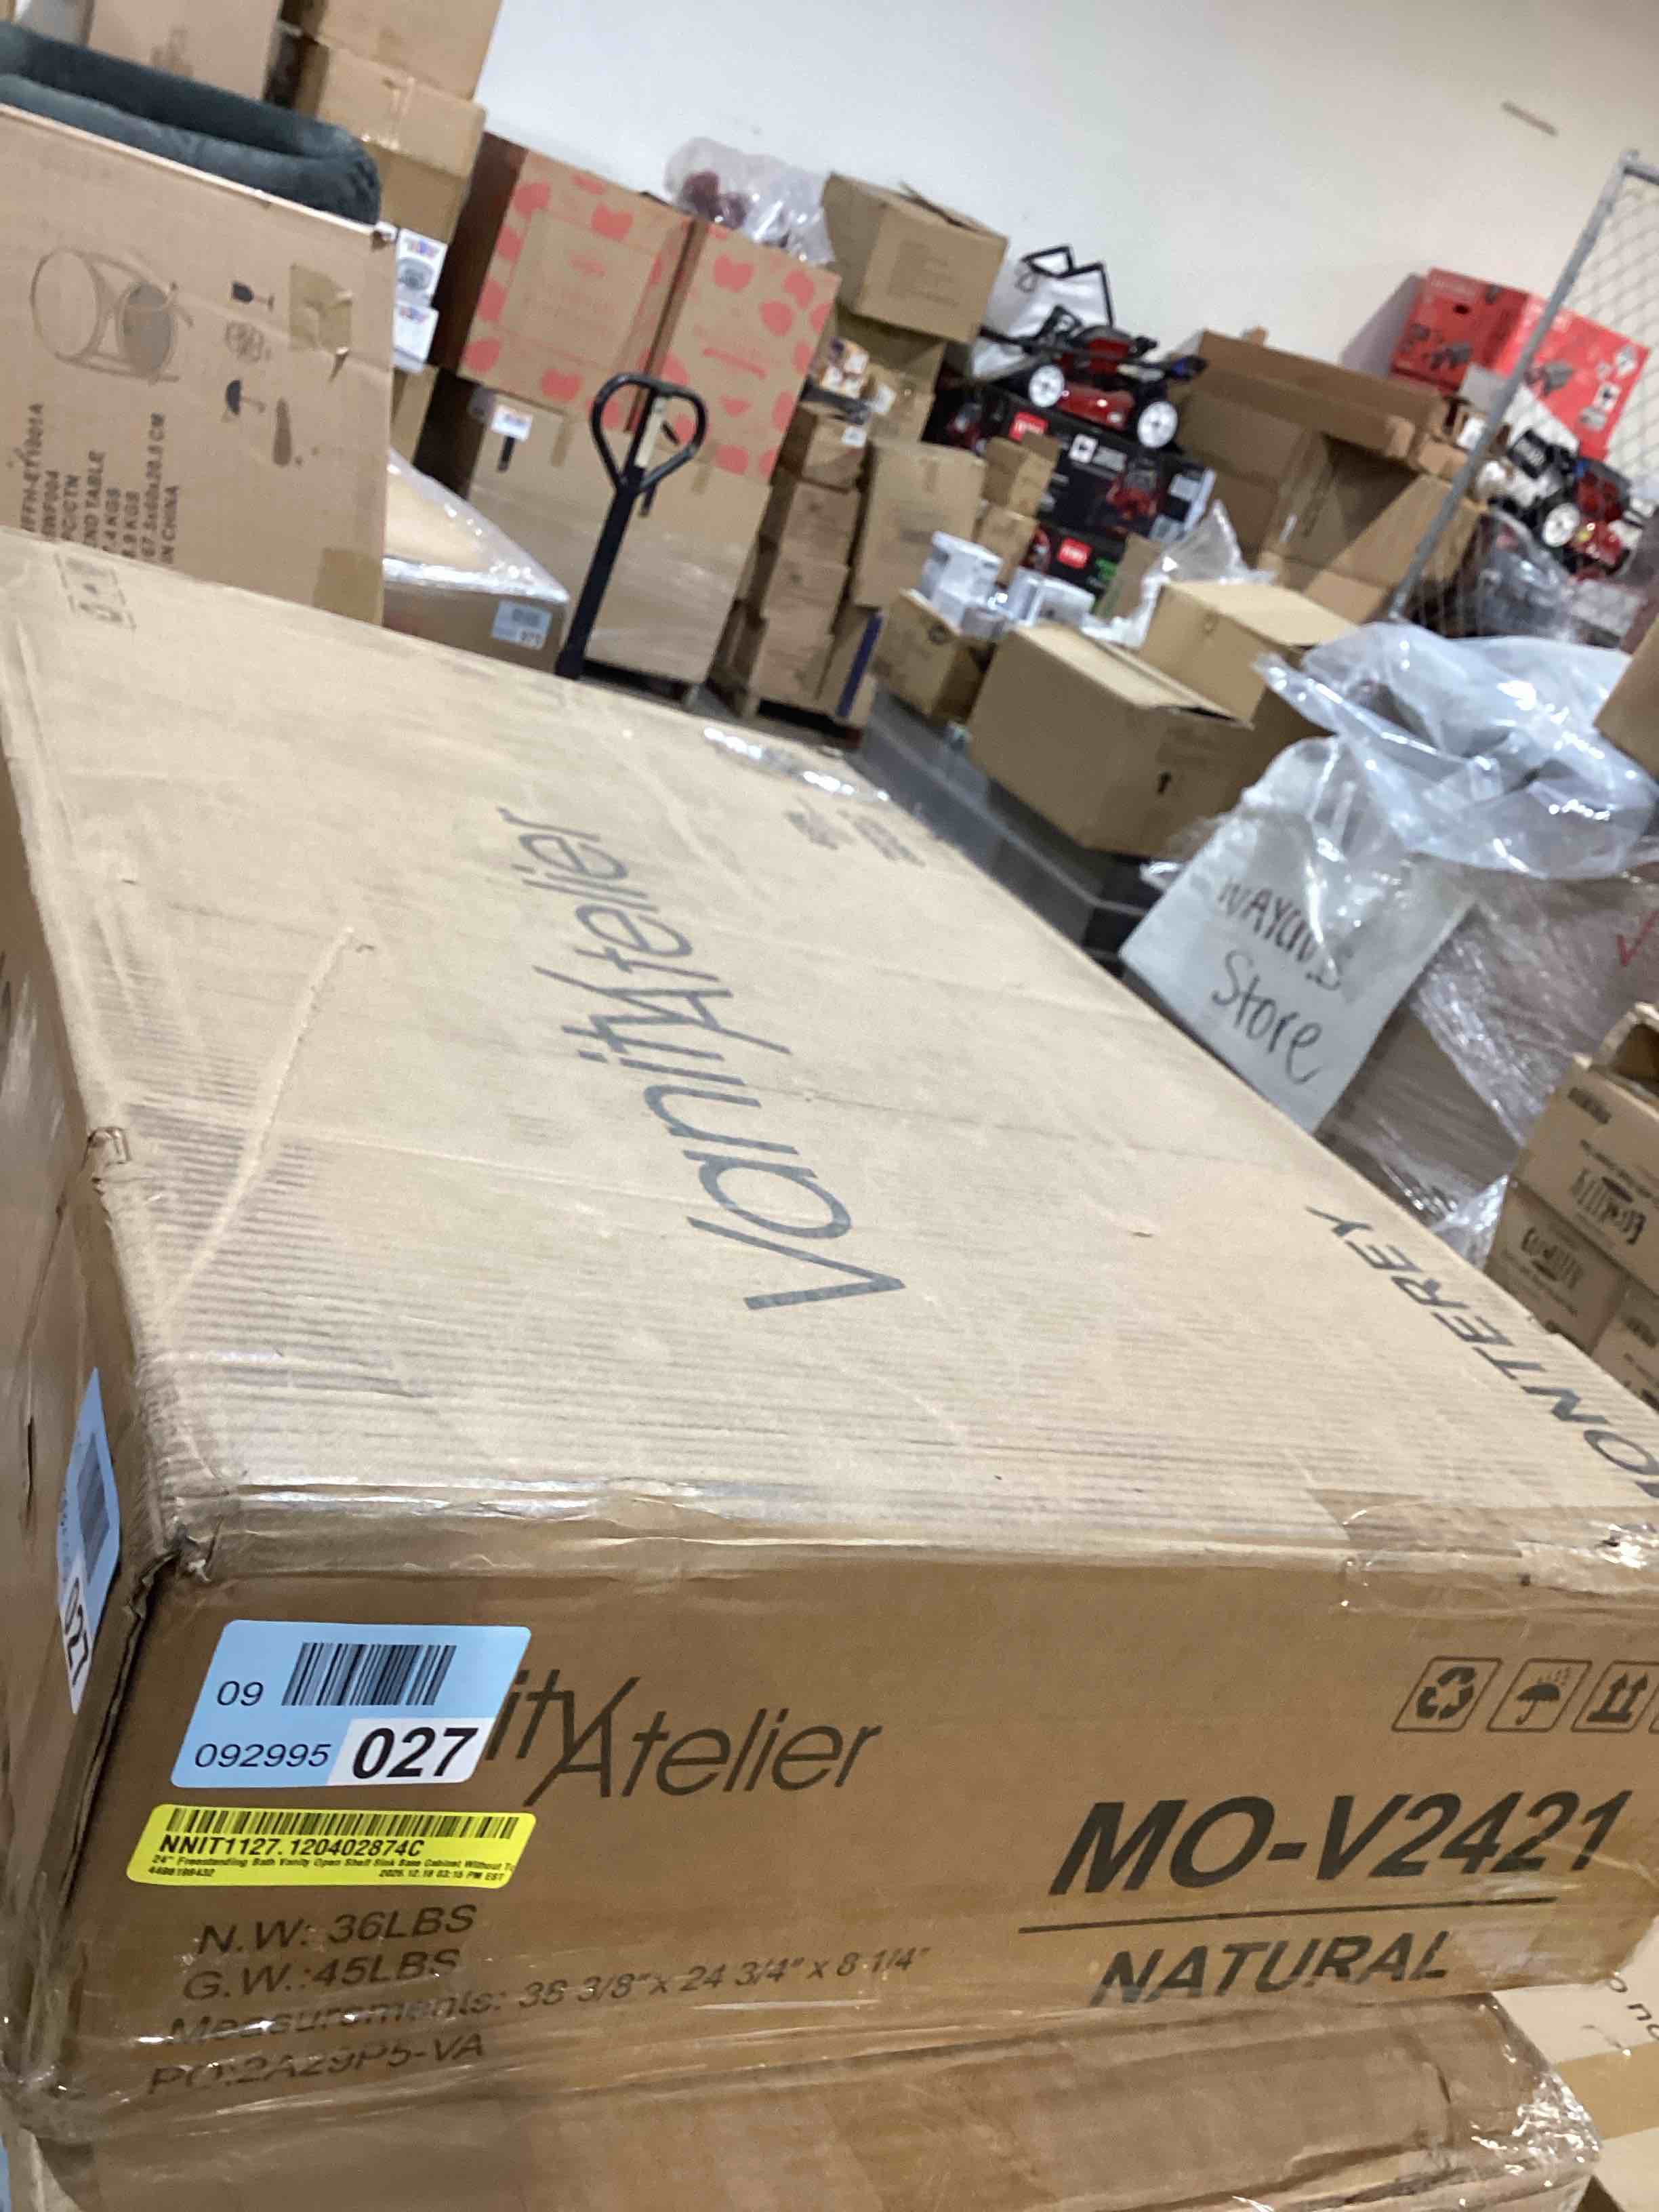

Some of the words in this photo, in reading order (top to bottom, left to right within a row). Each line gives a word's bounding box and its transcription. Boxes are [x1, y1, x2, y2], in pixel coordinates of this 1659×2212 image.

[85, 450, 106, 508] TABLE
[162, 485, 179, 541] CHINA
[1211, 950, 1324, 1084] Store
[1305, 1206, 1659, 1498] ONTEREY
[62, 1575, 89, 1687] 027
[216, 1680, 264, 1706] 09
[195, 1743, 332, 1768] 092995
[352, 1726, 479, 1780] 027
[178, 1856, 248, 1867] Freestanding
[279, 1858, 310, 1868] Vanity
[344, 1858, 371, 1867] Shelf
[424, 1859, 462, 1868] Cabinet
[464, 1860, 502, 1869] Without
[1048, 1789, 1633, 1896] MO-V2421
[485, 1872, 505, 1881] EST
[327, 1904, 478, 1944] 36LBS
[678, 1964, 725, 1992] 24
[836, 1951, 859, 1977] 8
[1087, 1930, 1452, 2007] NATURAL
